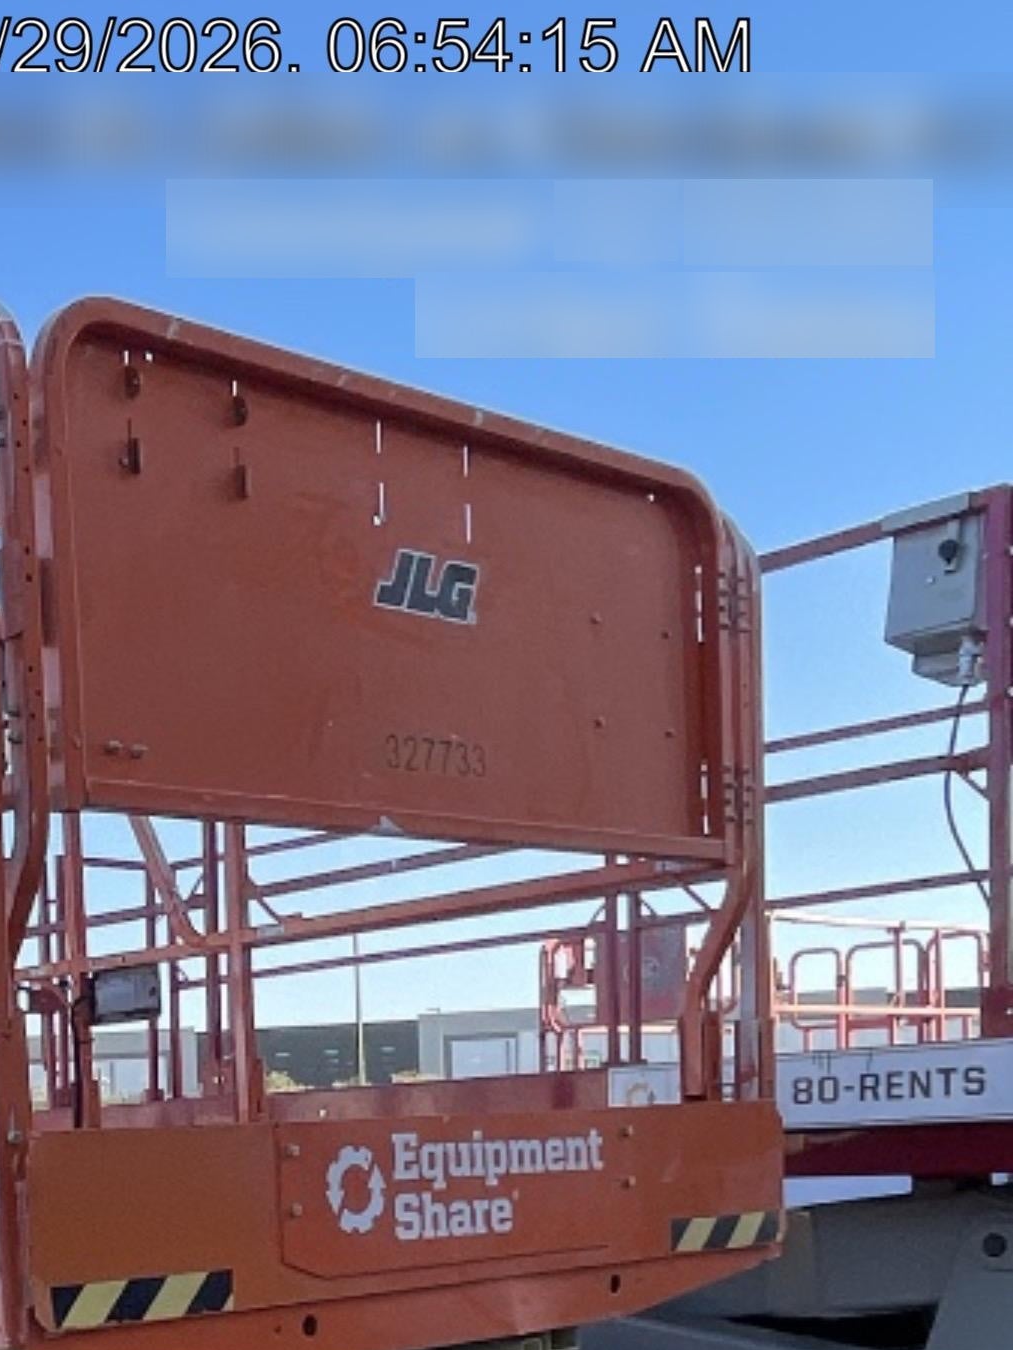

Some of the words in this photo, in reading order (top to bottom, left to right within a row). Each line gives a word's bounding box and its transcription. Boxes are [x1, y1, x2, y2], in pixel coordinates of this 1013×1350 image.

[373, 548, 479, 624] JLG
[385, 734, 486, 777] 327733
[792, 1065, 986, 1104] 80-RENTS
[391, 1128, 603, 1188] Equipment
[394, 1191, 514, 1239] Share
